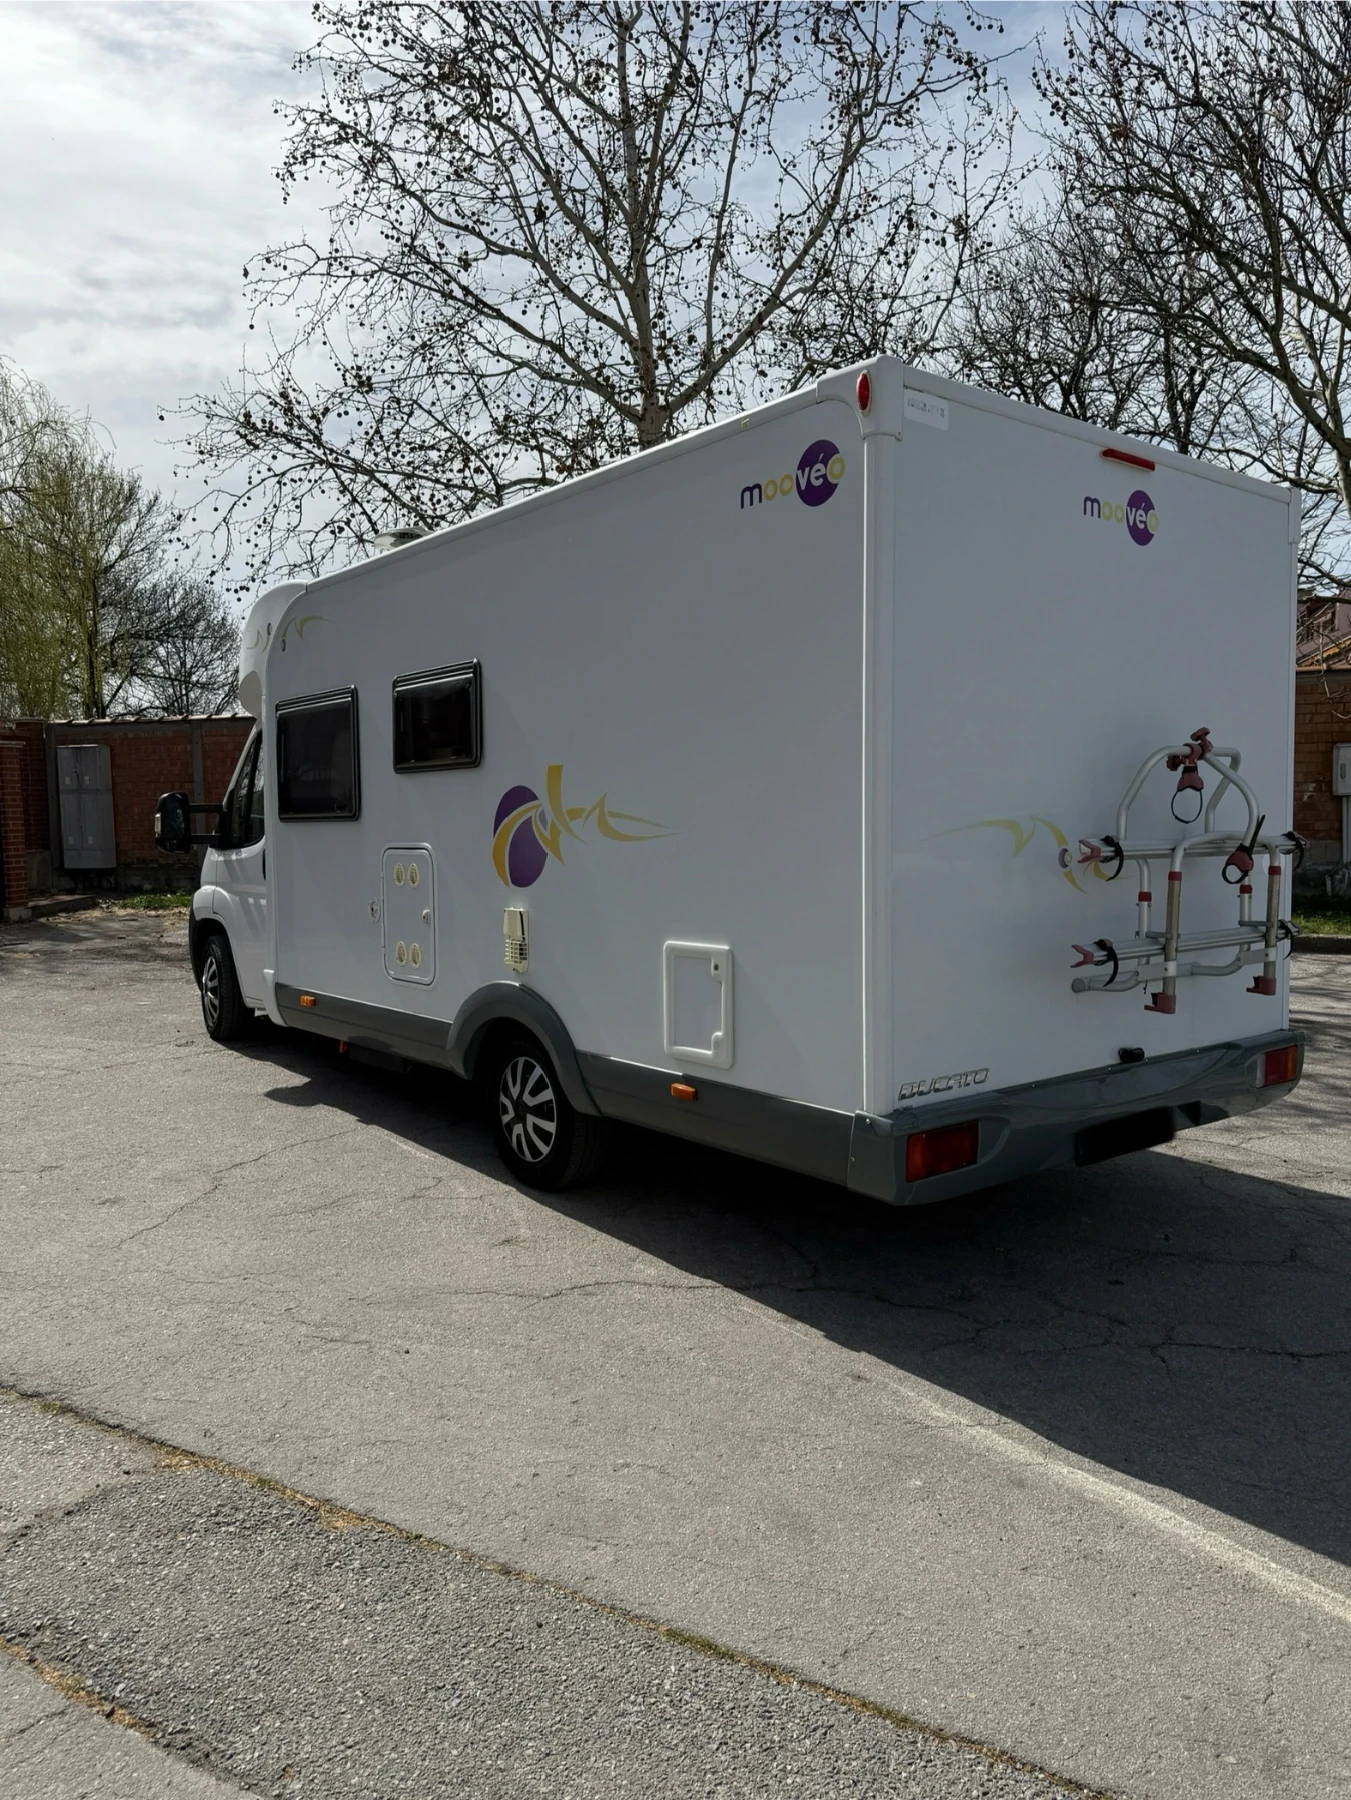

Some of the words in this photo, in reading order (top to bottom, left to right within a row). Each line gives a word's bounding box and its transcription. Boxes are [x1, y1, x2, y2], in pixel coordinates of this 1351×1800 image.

[741, 453, 846, 509] moovéo
[1083, 496, 1159, 532] moovéo
[898, 1068, 991, 1101] DUCATO
